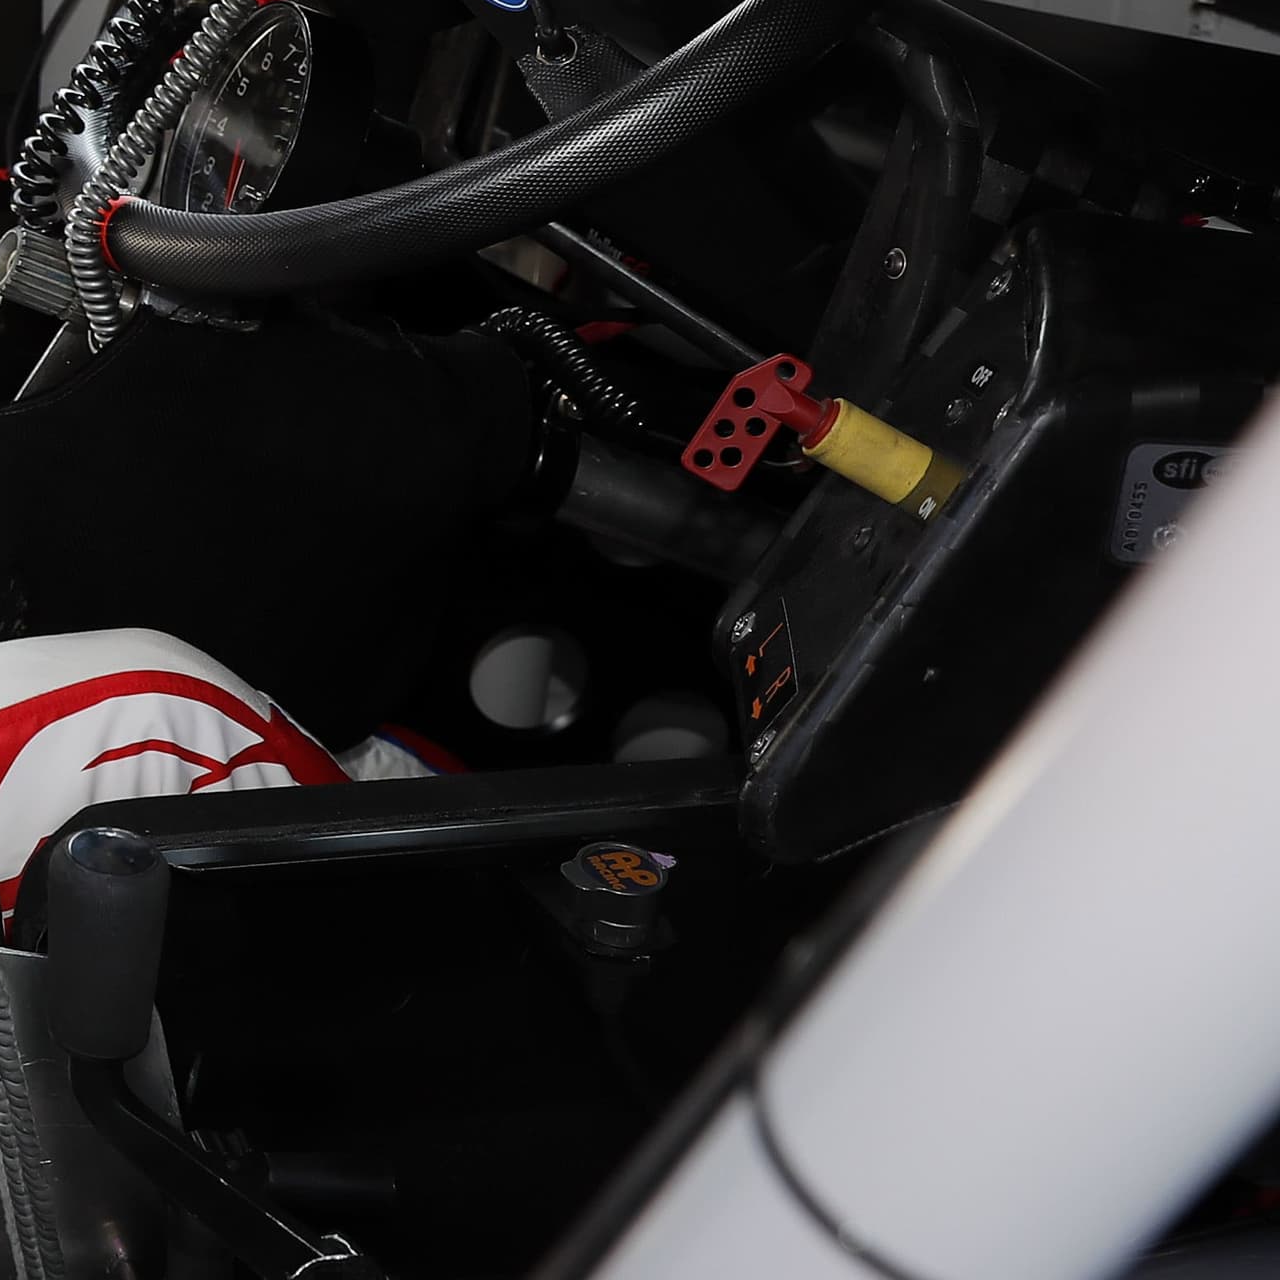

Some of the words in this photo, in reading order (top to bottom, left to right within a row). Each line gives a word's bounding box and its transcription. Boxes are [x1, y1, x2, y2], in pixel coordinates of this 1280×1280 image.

[970, 365, 994, 388] OFF
[1163, 458, 1198, 480] sfi
[918, 496, 937, 521] ON
